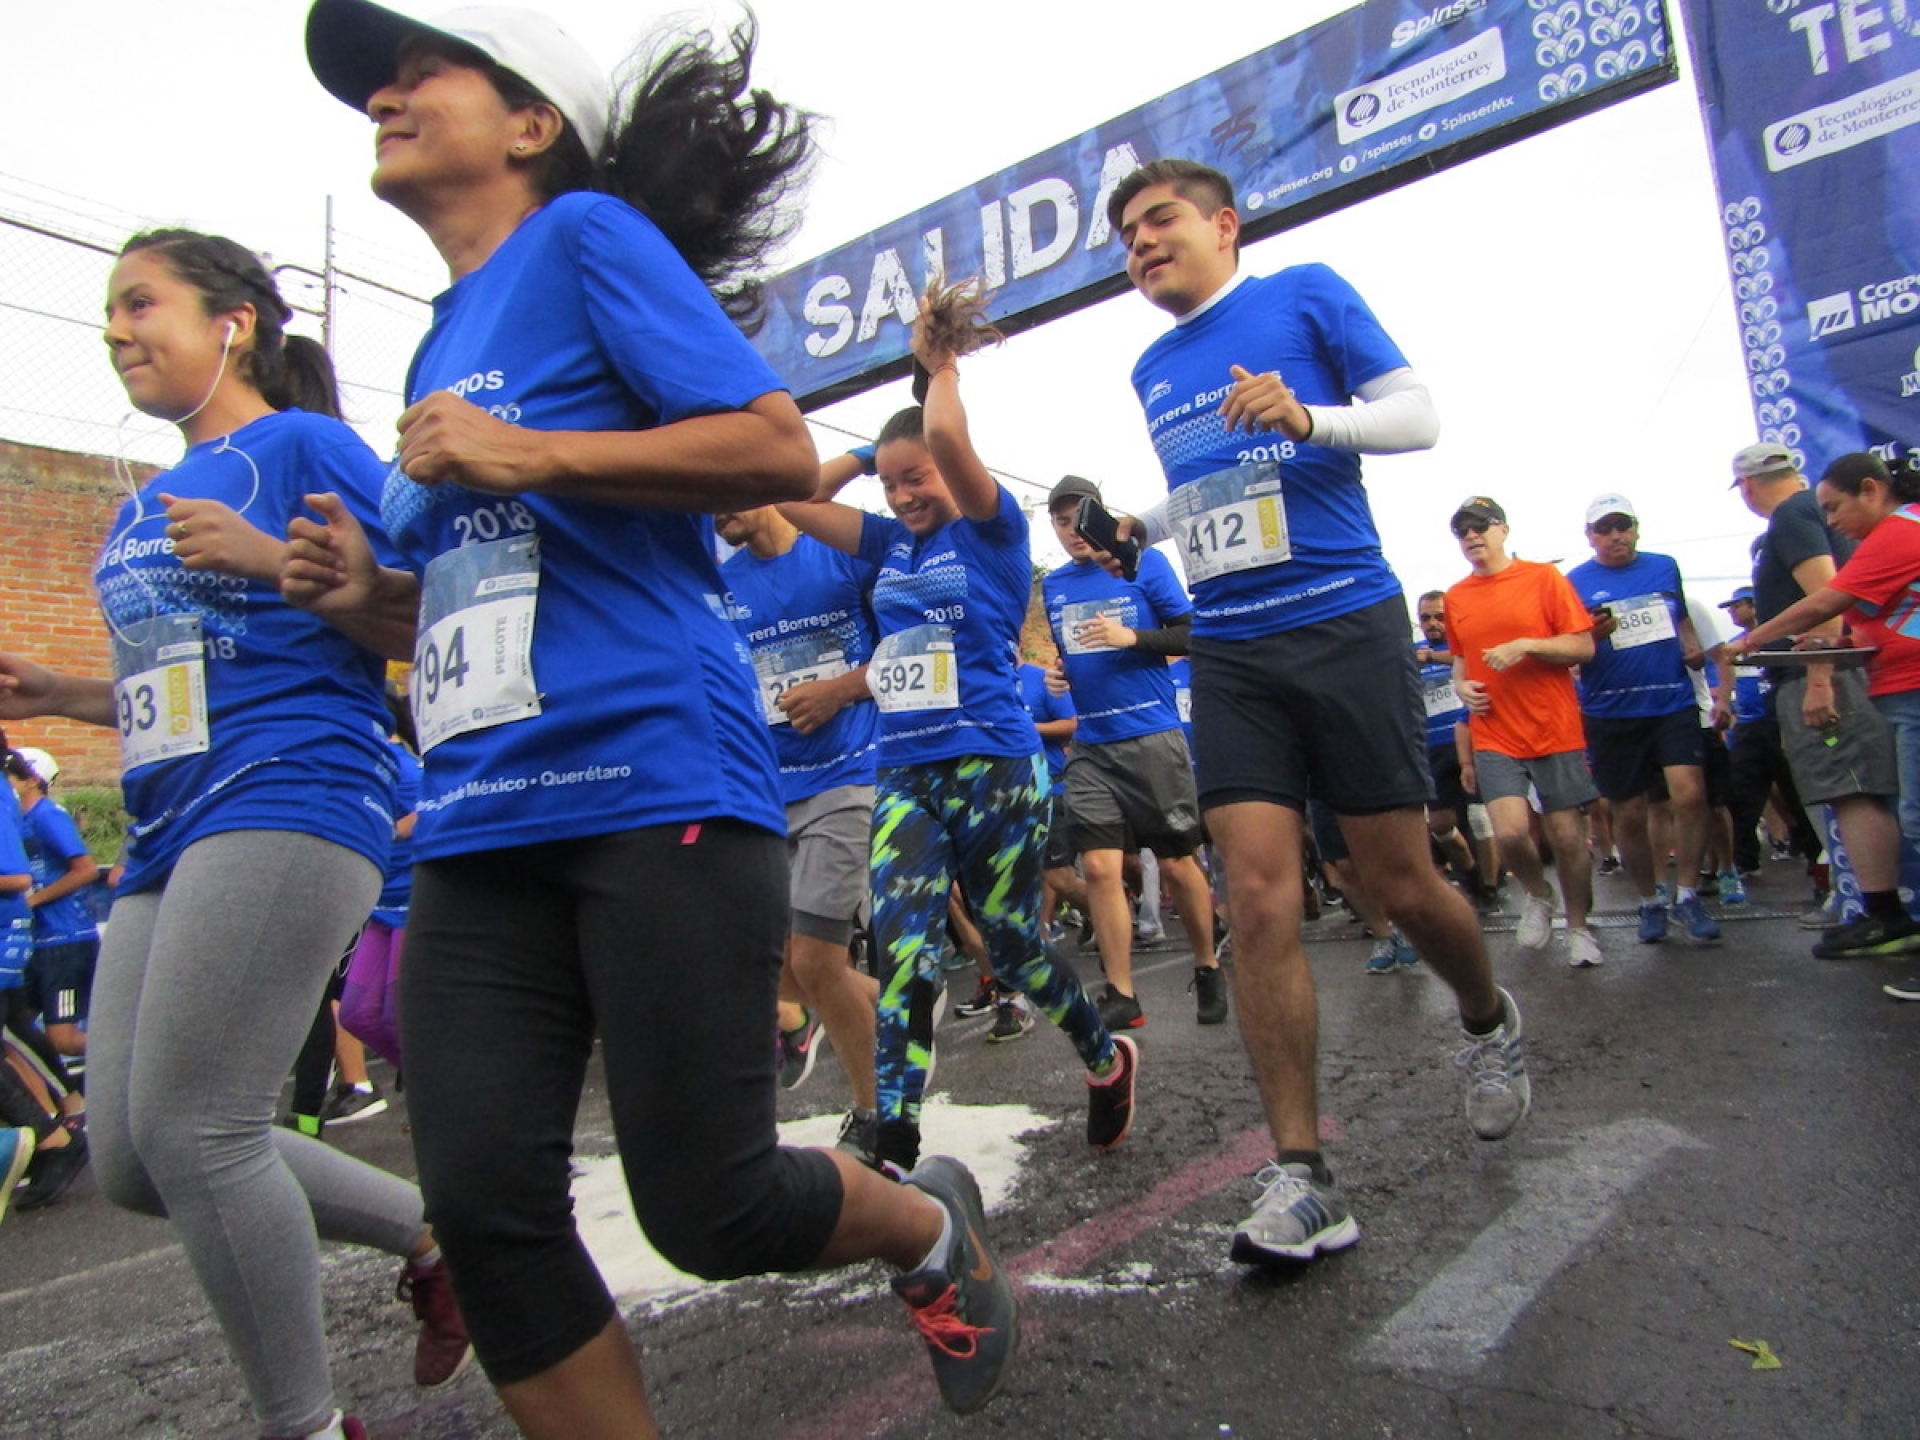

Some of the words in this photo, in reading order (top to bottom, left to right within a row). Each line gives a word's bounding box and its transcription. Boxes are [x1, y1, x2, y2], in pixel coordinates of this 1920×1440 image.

[1385, 51, 1478, 98] Tecnológico
[1386, 97, 1406, 113] de
[1411, 61, 1493, 103] Monterrey
[1441, 95, 1515, 131] SpinserMx
[1816, 87, 1913, 128] Tecnológico
[1818, 130, 1838, 143] de
[1842, 98, 1920, 136] Monterre
[1361, 134, 1412, 163] /spinser
[1267, 166, 1334, 200] spinser.org
[803, 142, 1144, 358] SALIDA
[1858, 275, 1920, 302] CORP
[1237, 440, 1296, 466] 2018
[454, 501, 537, 548] 2018
[1189, 512, 1247, 557] 412
[778, 608, 848, 634] Borregos
[923, 604, 965, 623] 2018
[1620, 611, 1653, 630] 686
[880, 663, 925, 693] 592
[466, 776, 527, 798] México
[540, 764, 632, 787] Querétaro
